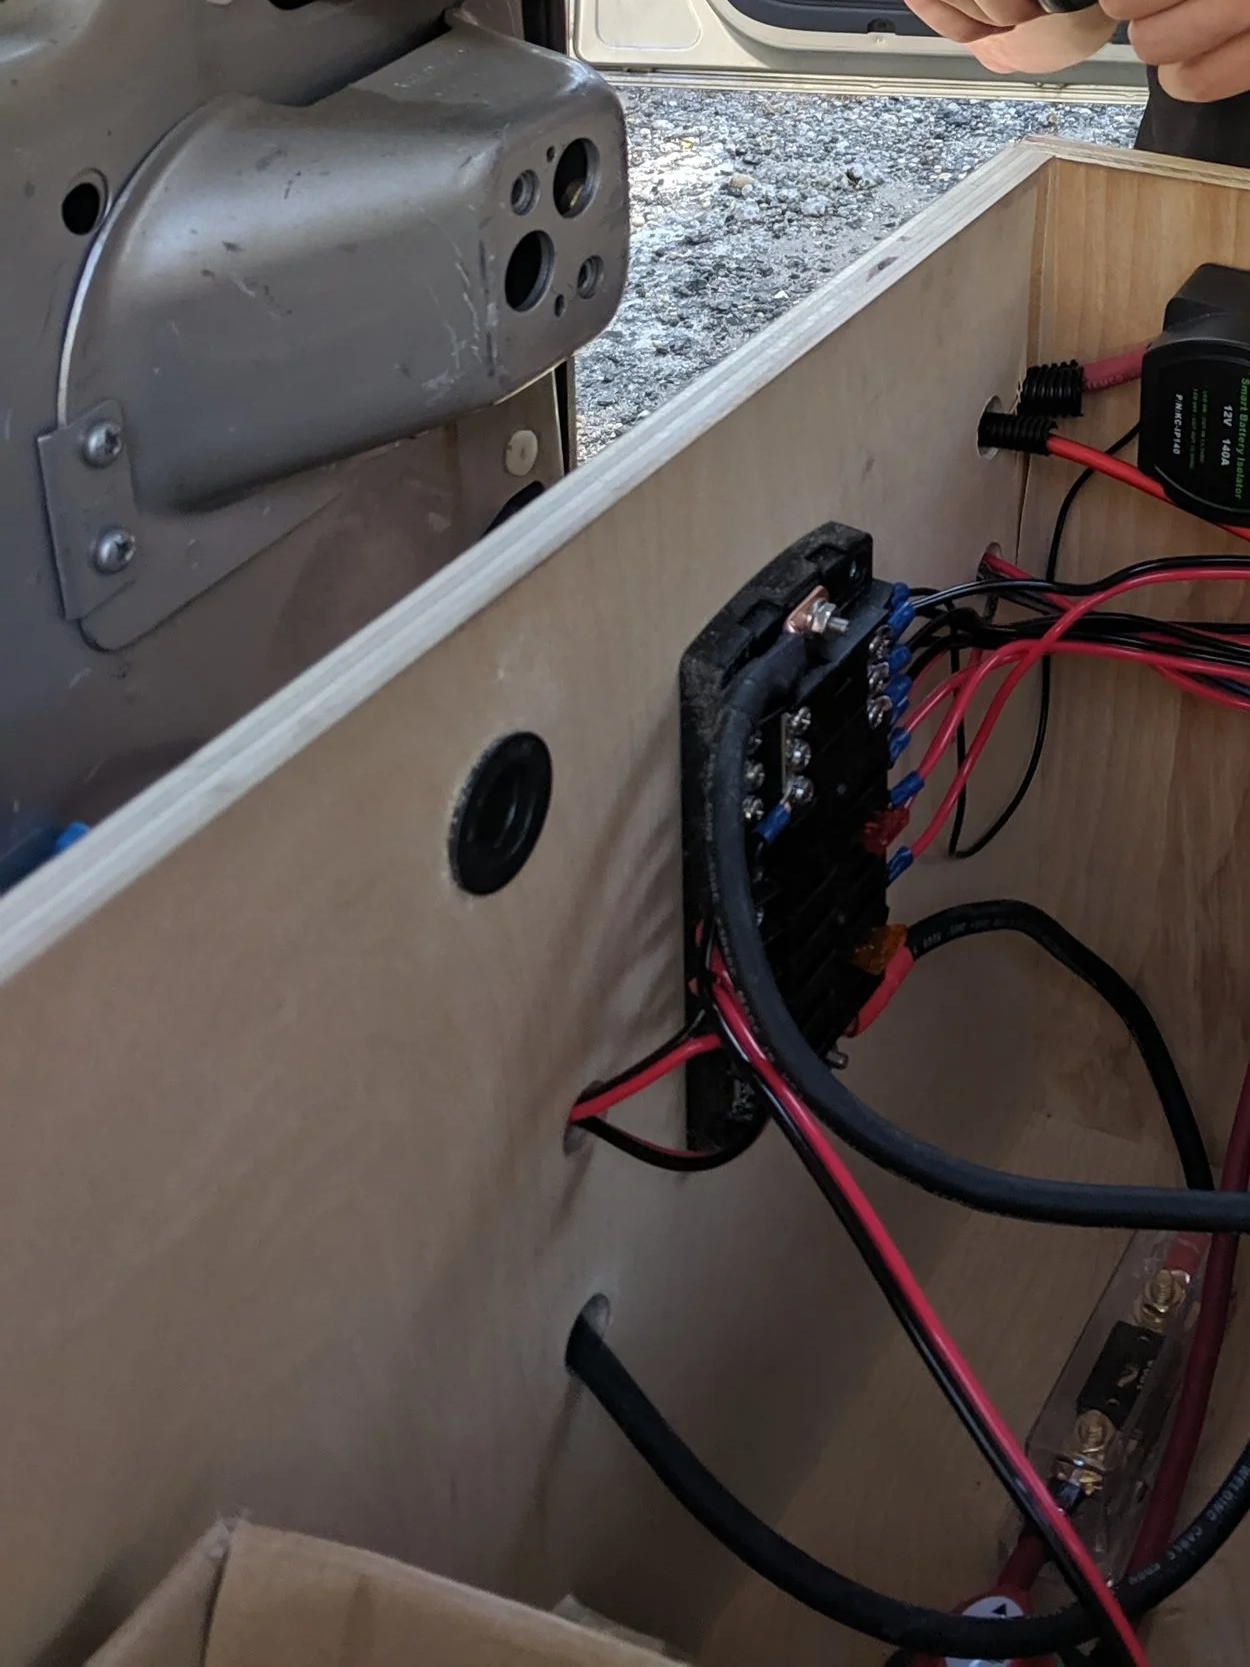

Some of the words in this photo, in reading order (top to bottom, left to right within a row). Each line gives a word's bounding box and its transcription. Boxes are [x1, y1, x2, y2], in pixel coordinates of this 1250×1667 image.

[1240, 377, 1250, 411] Smart
[1223, 405, 1233, 427] 12V
[1235, 414, 1248, 455] Battery
[1220, 438, 1232, 466] 140A
[1234, 457, 1246, 499] Isolator
[1205, 1464, 1250, 1522] WELDING
